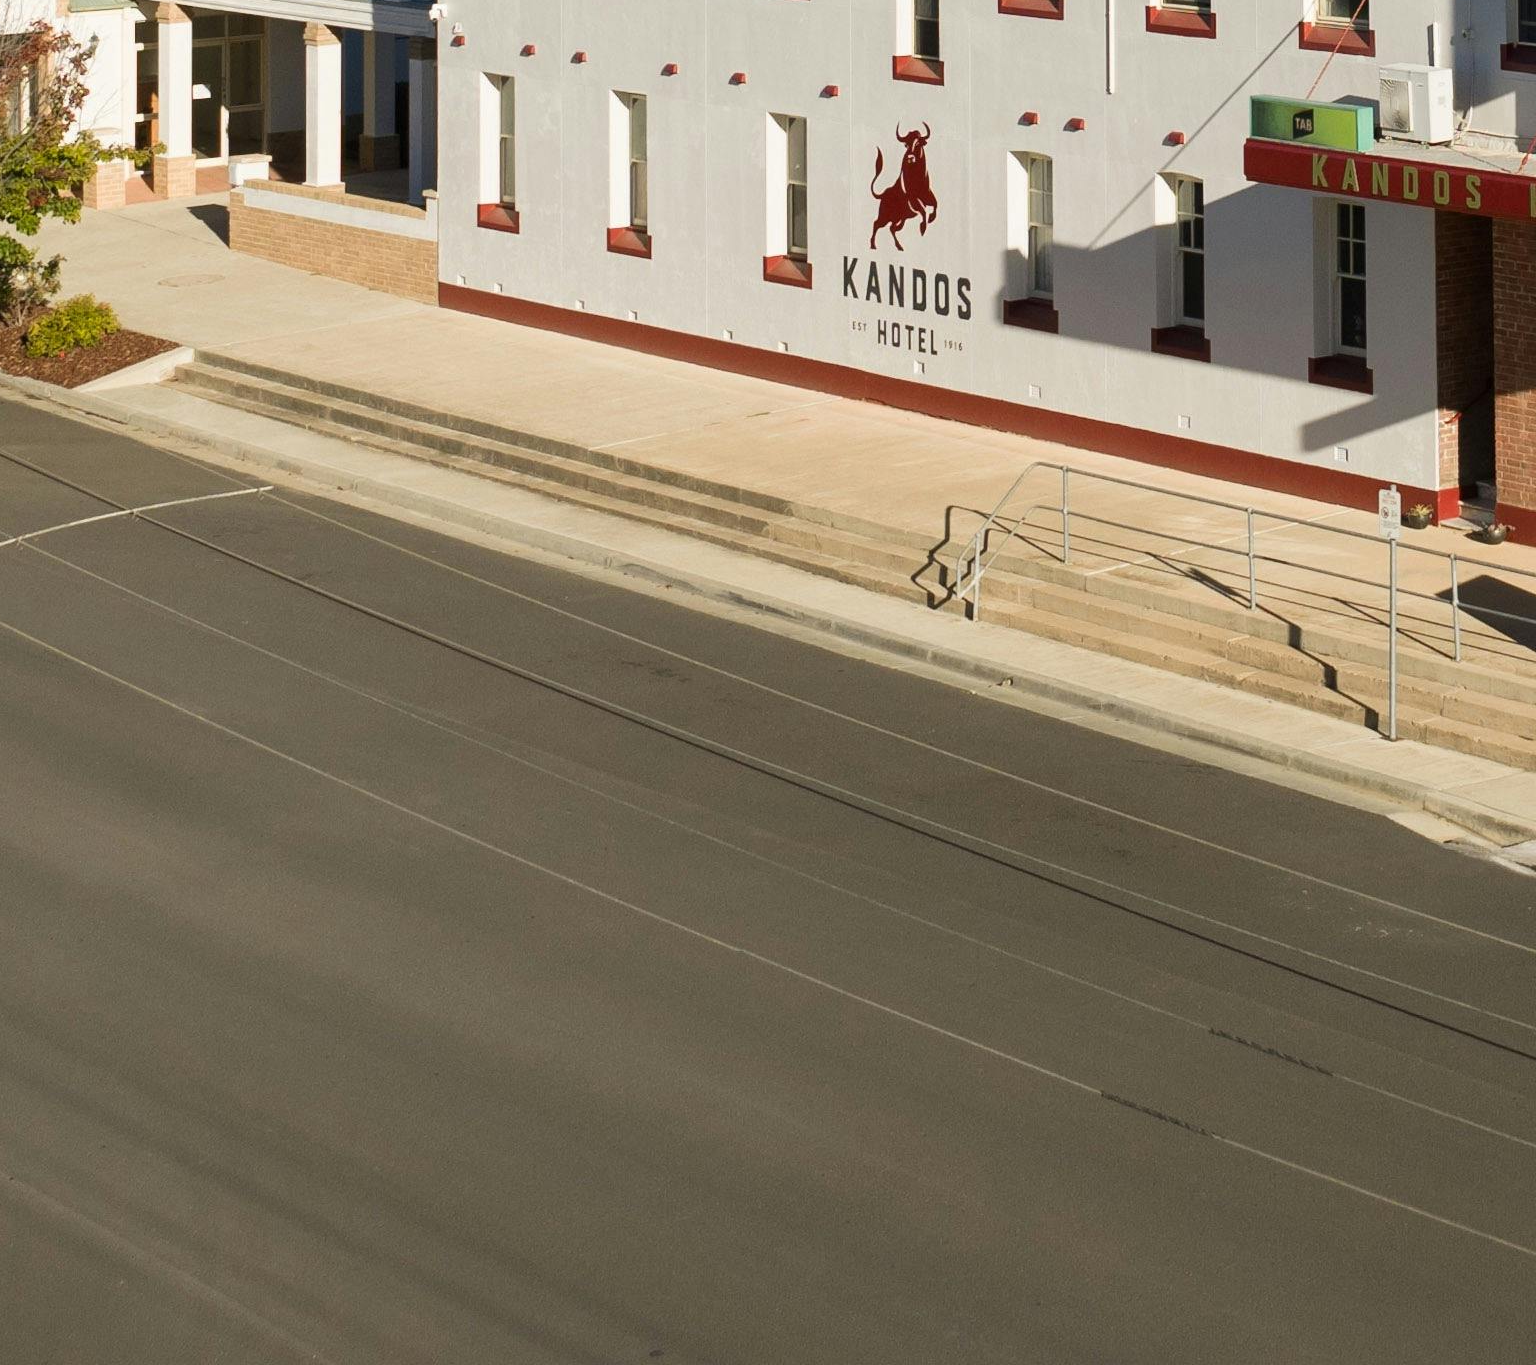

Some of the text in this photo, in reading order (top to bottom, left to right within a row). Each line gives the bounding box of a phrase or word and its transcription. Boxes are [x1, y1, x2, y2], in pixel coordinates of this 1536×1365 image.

[1295, 117, 1312, 131] TAB
[1313, 153, 1482, 209] KANDOS
[843, 256, 971, 320] KANDOS
[852, 319, 963, 356] EST HOTEL 1916
